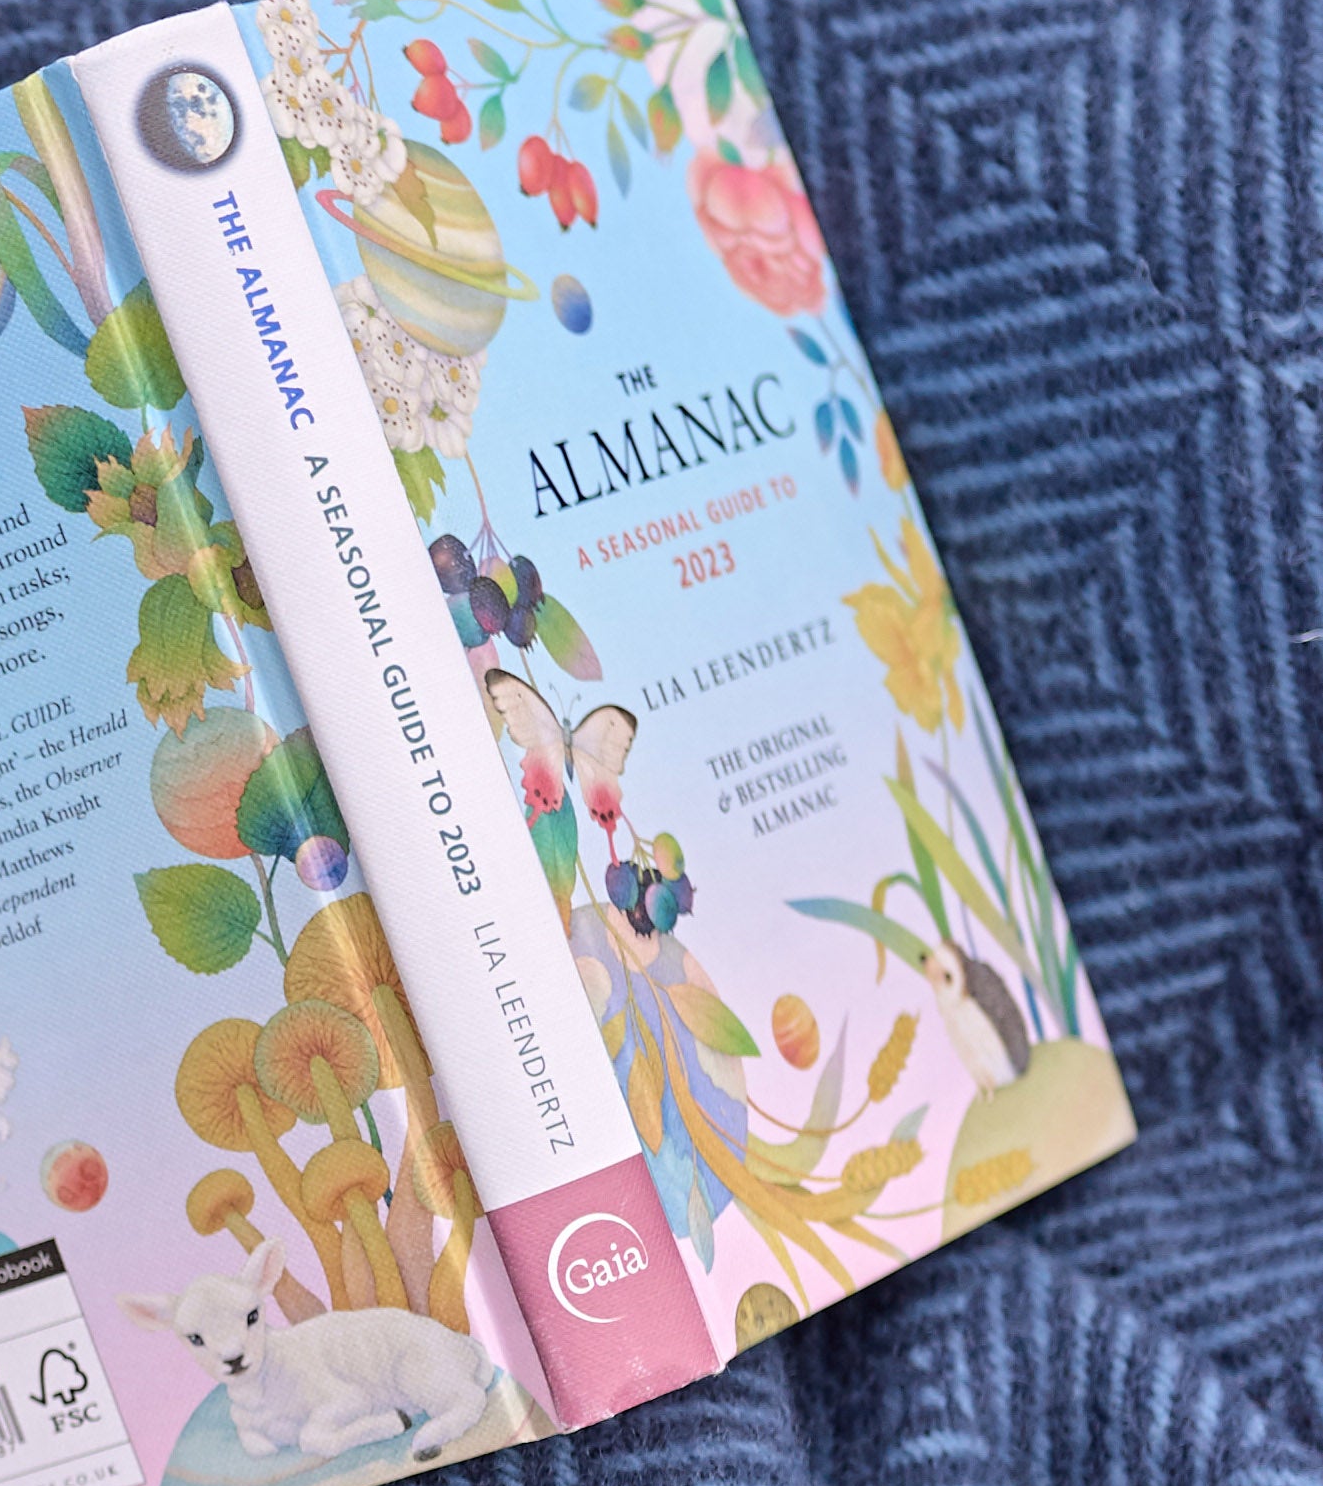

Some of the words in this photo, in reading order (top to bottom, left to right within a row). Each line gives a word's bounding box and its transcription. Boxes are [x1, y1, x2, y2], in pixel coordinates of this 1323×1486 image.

[211, 189, 254, 258] THE
[234, 266, 316, 432] ALMANAC
[615, 364, 658, 396] THE
[302, 454, 331, 480] A
[528, 372, 797, 519] ALMANAC
[576, 546, 594, 572] A
[596, 509, 703, 564] SEASONAL
[704, 484, 768, 526] GUIDE
[767, 474, 798, 502] TO
[6, 565, 72, 602] tasks;
[315, 484, 394, 659] SEASONAL
[672, 540, 737, 590] 2023
[640, 675, 687, 712] LIA
[691, 616, 835, 693] LEENDERTZ
[9, 694, 72, 735] GUIDE
[37, 737, 66, 760] the
[68, 707, 129, 748] Herald
[381, 663, 436, 766] GUIDE
[705, 748, 748, 781] THE
[746, 714, 833, 765] ORIGINAL
[13, 781, 42, 804] the
[44, 751, 123, 792] Observer
[420, 768, 454, 817] TO
[717, 790, 733, 816] &
[734, 745, 849, 808] BESTSELLING
[40, 793, 103, 828] Knight
[751, 784, 837, 837] ALMANAC
[437, 823, 483, 897] 2023
[472, 920, 508, 974] LIA
[494, 979, 576, 1156] LEENDERTZ
[564, 1233, 649, 1297] Gaia
[49, 1402, 102, 1435] FSC
